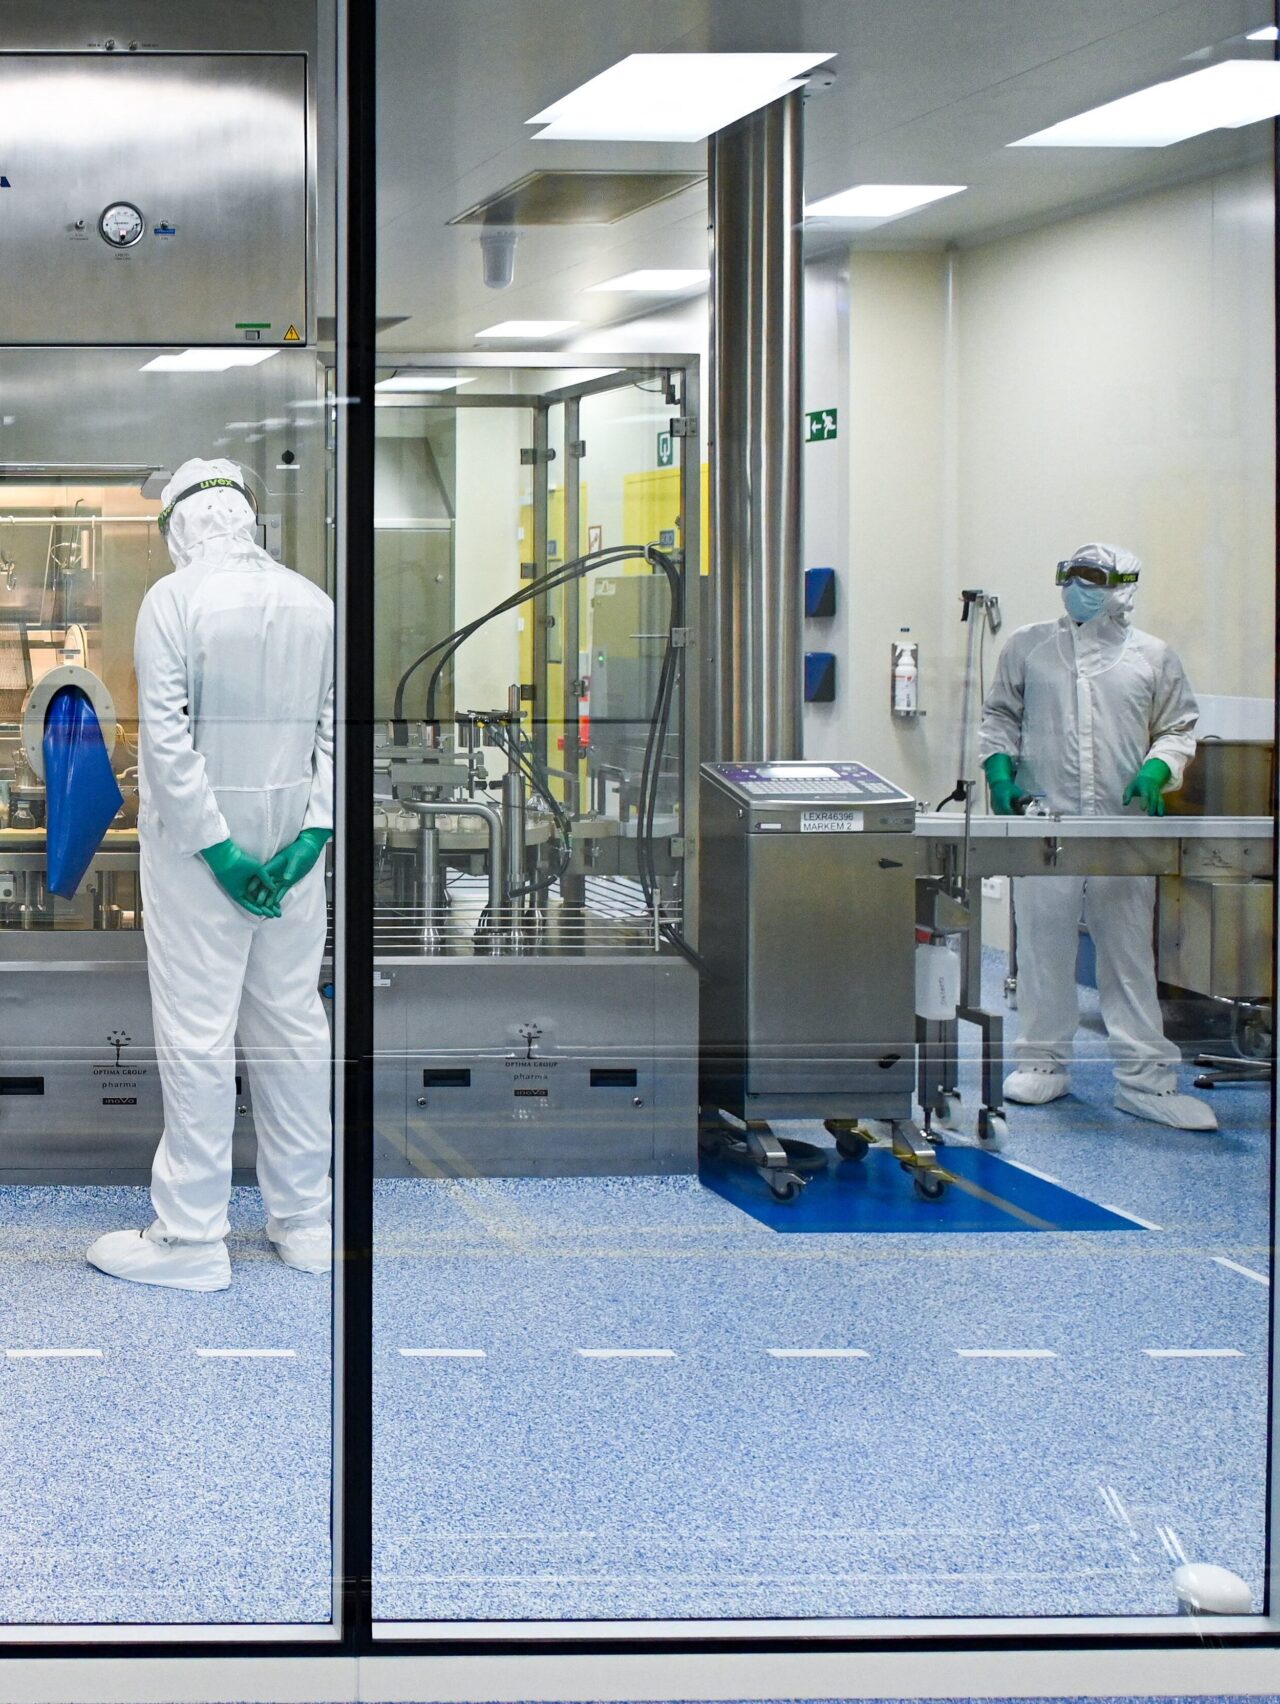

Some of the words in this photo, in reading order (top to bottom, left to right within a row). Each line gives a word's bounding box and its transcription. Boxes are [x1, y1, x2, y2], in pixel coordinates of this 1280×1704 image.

[200, 479, 234, 489] uvex
[803, 811, 855, 821] LEXR46396
[803, 822, 845, 831] MARKEM
[846, 822, 852, 831] 2
[102, 1081, 137, 1089] pharma
